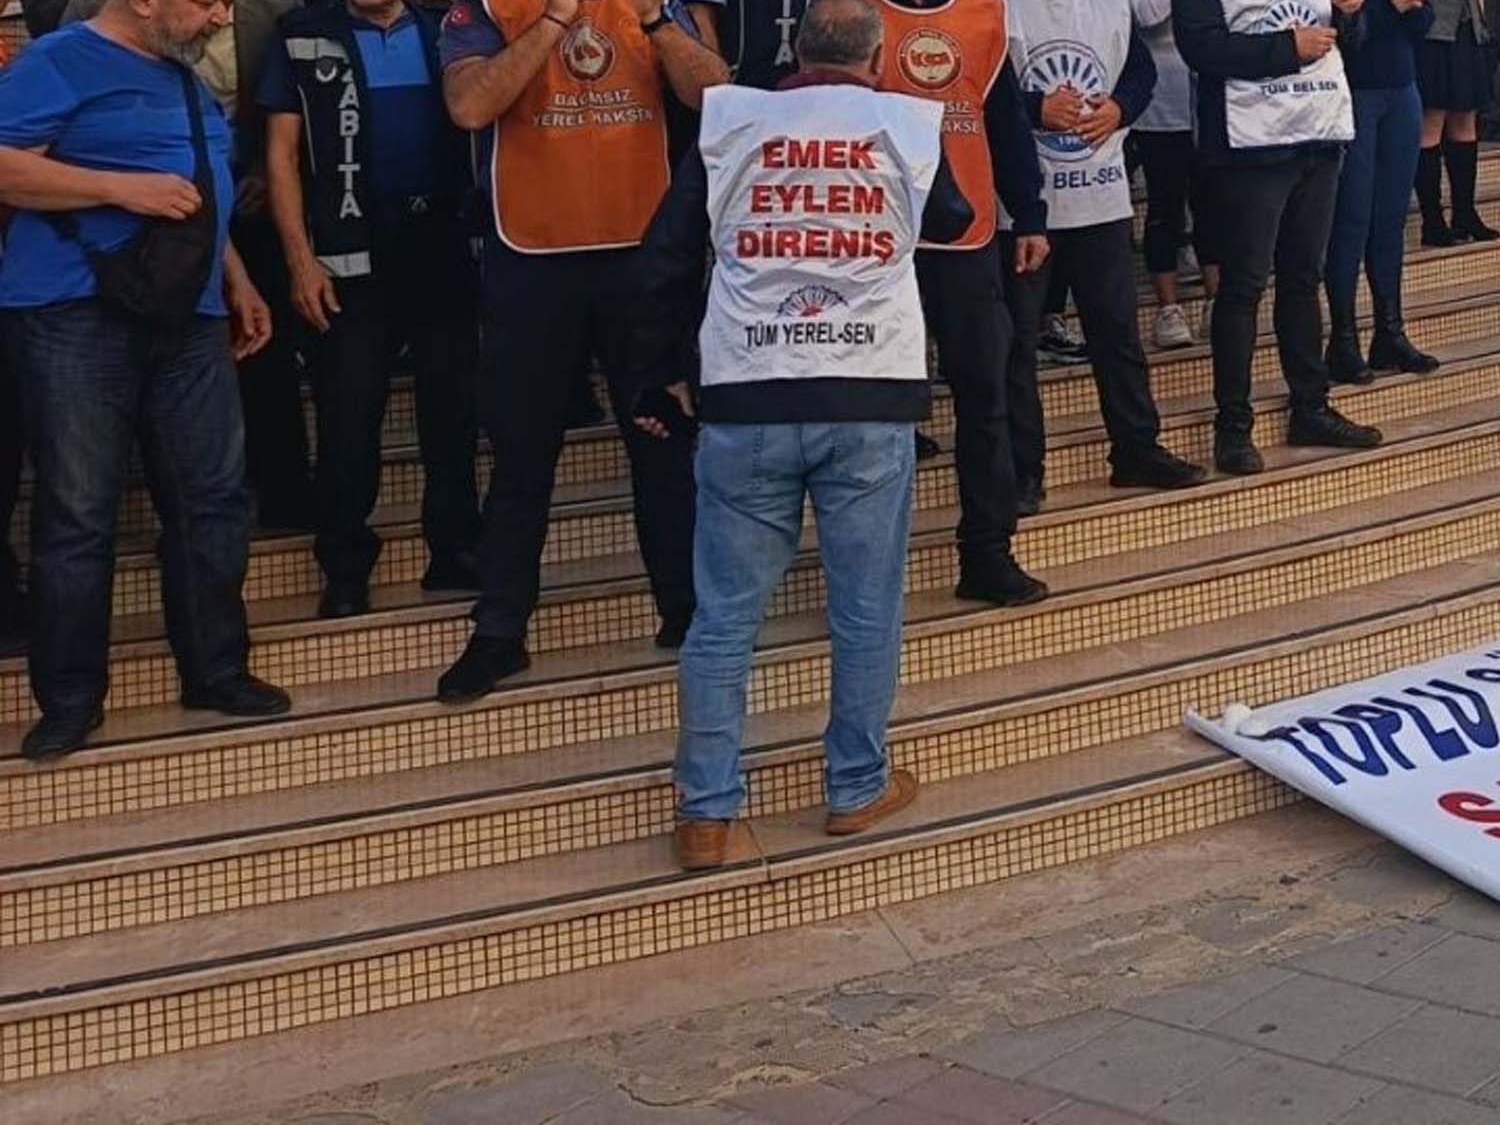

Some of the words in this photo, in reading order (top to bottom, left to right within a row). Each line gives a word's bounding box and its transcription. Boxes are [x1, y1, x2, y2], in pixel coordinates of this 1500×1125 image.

[762, 140, 876, 169] EMEK
[750, 184, 884, 214] EYLEM
[736, 222, 894, 267] DİRENİŞ
[745, 321, 778, 347] TÜM
[782, 322, 876, 346] YEREL-SEN
[1262, 678, 1500, 786] TOPLU
